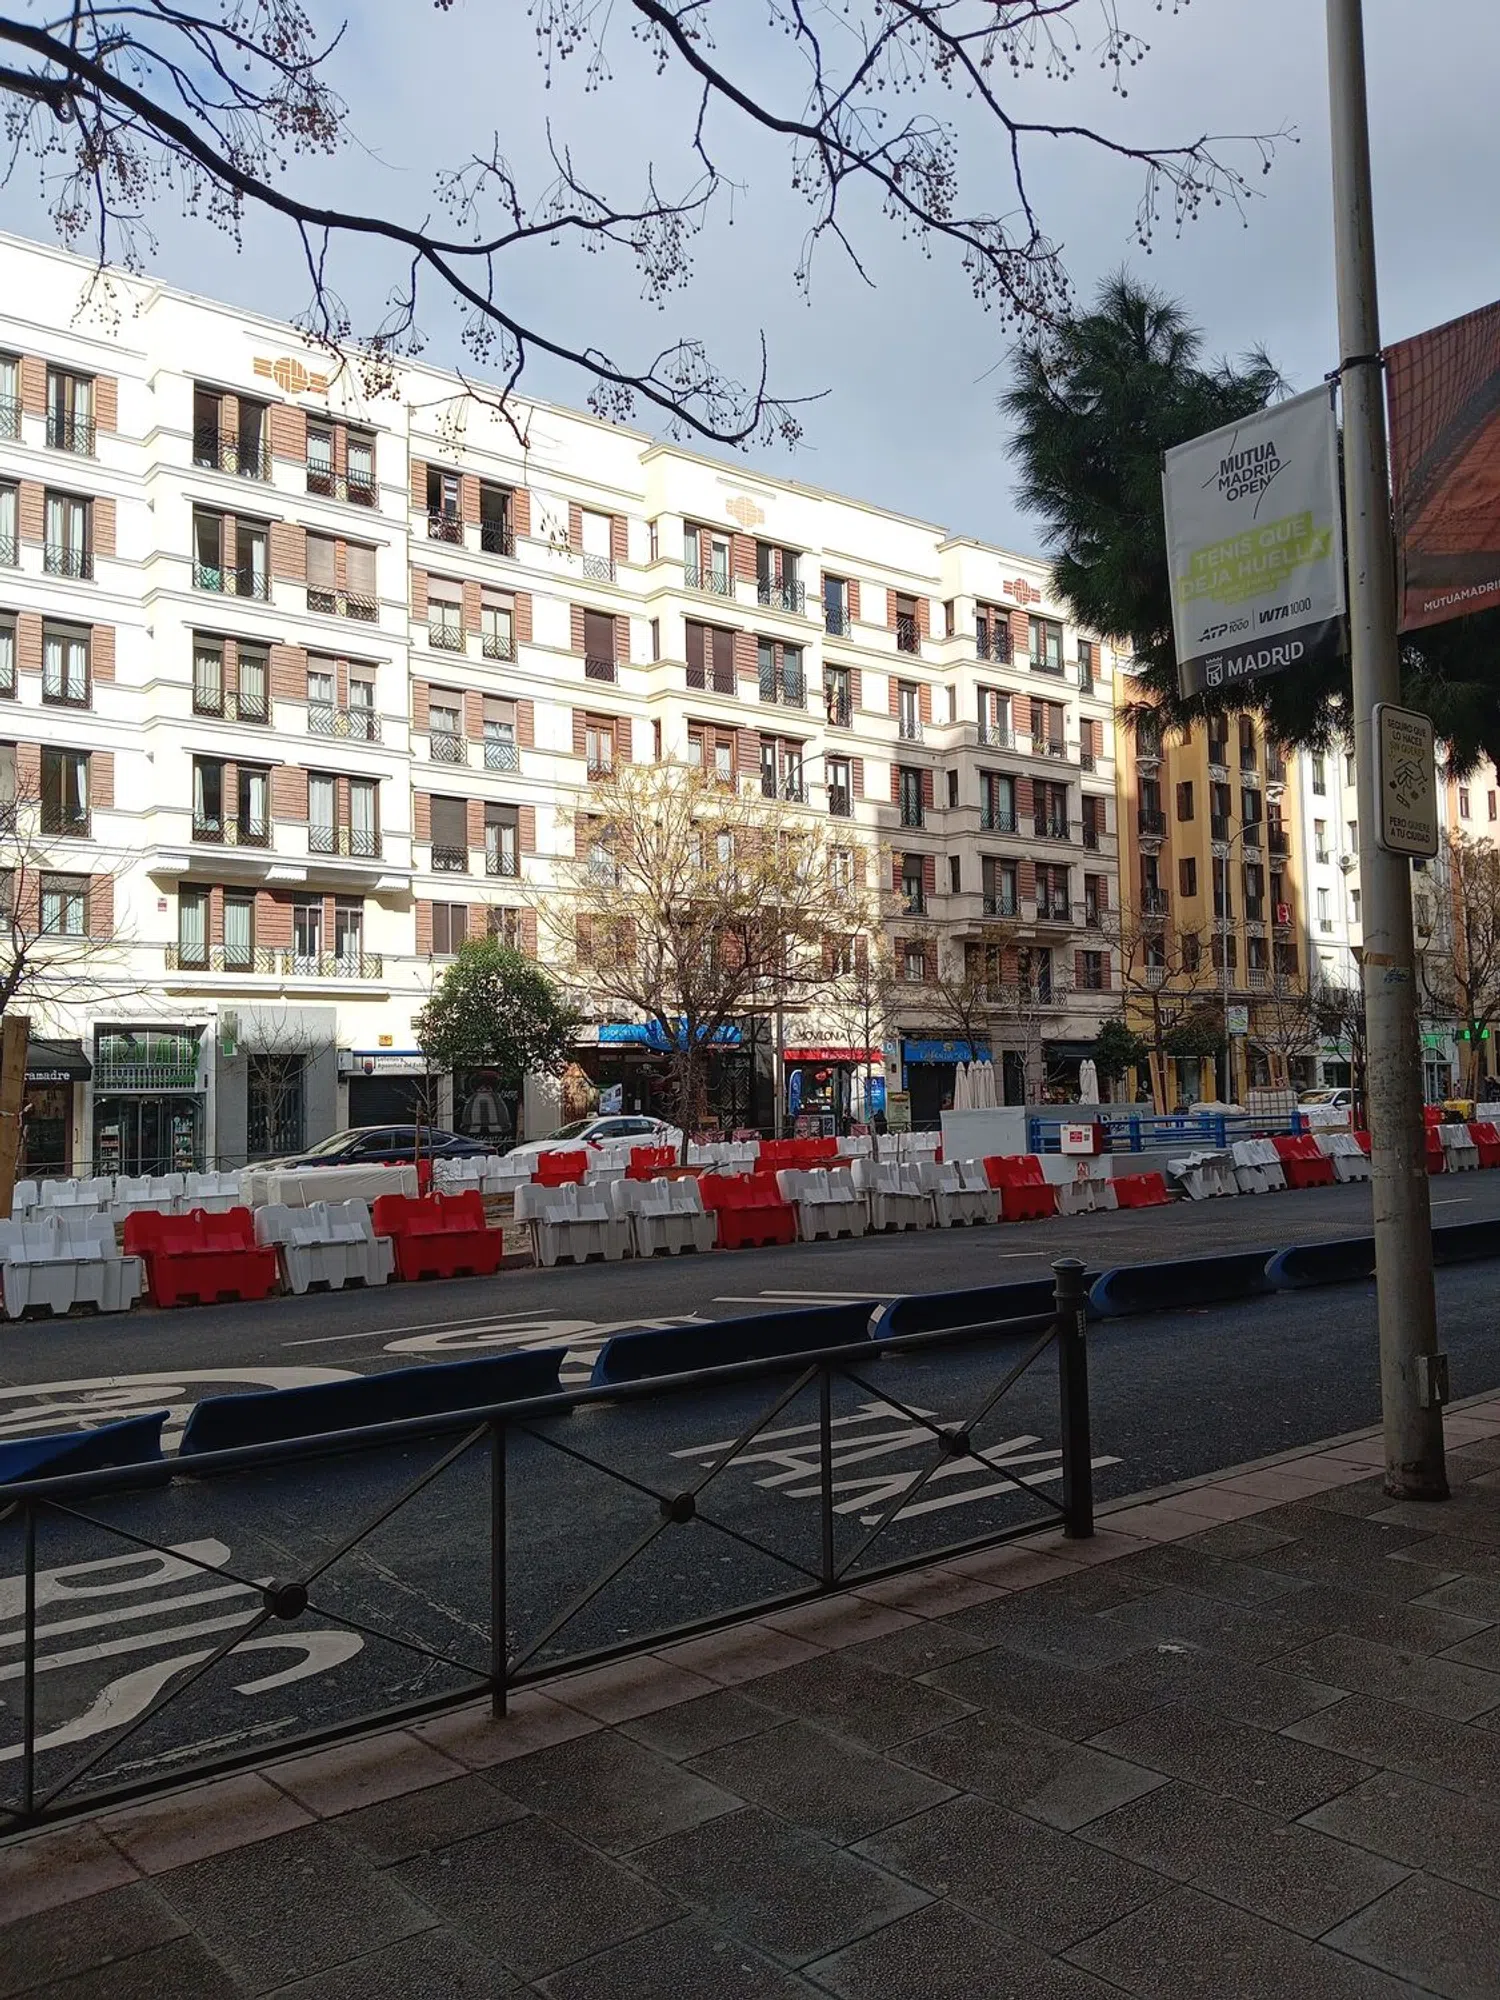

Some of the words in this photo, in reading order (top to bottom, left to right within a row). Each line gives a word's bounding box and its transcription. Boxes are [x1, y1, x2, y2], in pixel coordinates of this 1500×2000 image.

[1220, 441, 1276, 476] MUTUA
[1218, 458, 1281, 492] MADRID
[1226, 474, 1271, 502] OPEN
[1259, 518, 1307, 548] QUE
[1179, 567, 1232, 597] DEJA
[1239, 537, 1324, 577] HUELLA
[1227, 641, 1304, 677] MADRID
[1387, 718, 1413, 734] SEGURO
[1413, 725, 1427, 737] QUE
[1391, 731, 1401, 741] LO
[1389, 816, 1407, 828] PERO
[1390, 828, 1396, 837] A
[1396, 829, 1406, 839] TU
[1406, 830, 1431, 844] CIUDAD
[669, 1400, 1123, 1527] TAXI
